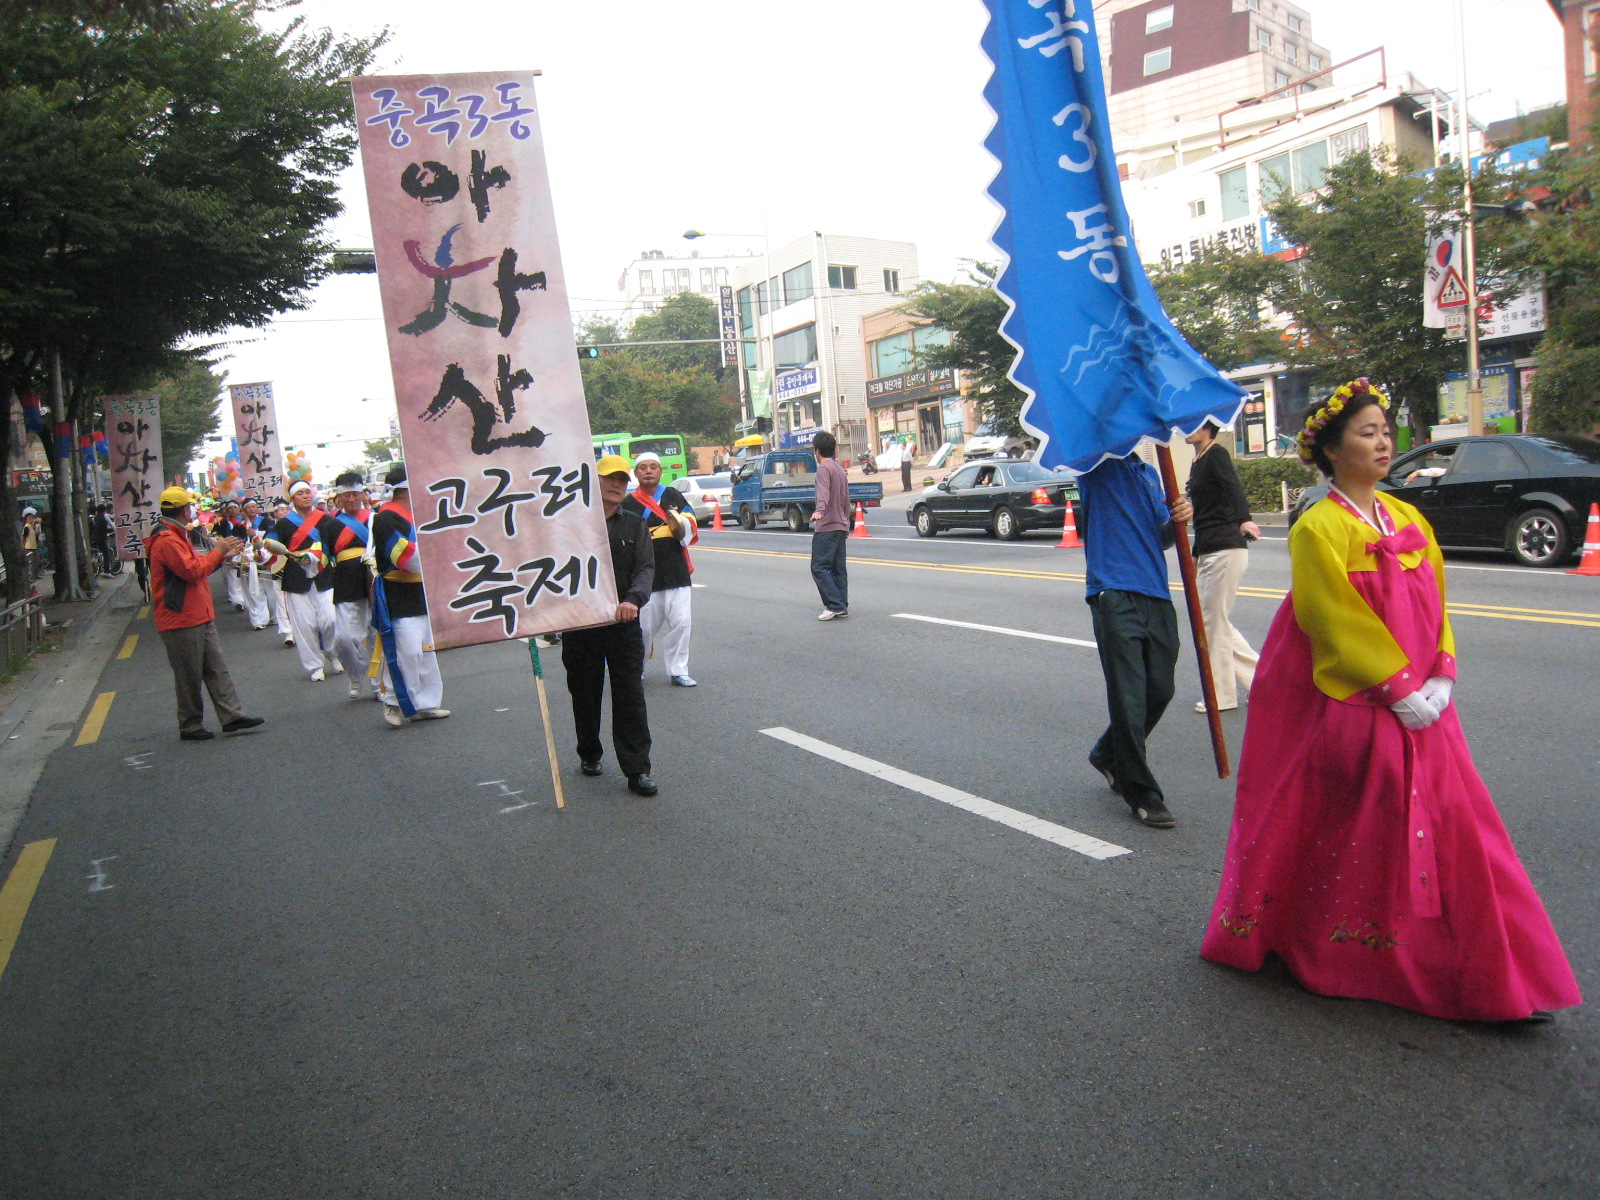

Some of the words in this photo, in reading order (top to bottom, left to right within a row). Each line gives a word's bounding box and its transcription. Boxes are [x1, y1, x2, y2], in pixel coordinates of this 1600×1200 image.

[365, 82, 536, 149] 중곡3동
[398, 150, 550, 456] 아차산
[234, 384, 272, 401] 중곡3동
[779, 386, 808, 399] 444-0112
[114, 419, 158, 508] 아차산
[240, 402, 274, 474] 아차산
[664, 447, 677, 455] 4212
[245, 475, 283, 491] 고구려
[417, 462, 591, 538] 고구려
[447, 537, 600, 637] 축제
